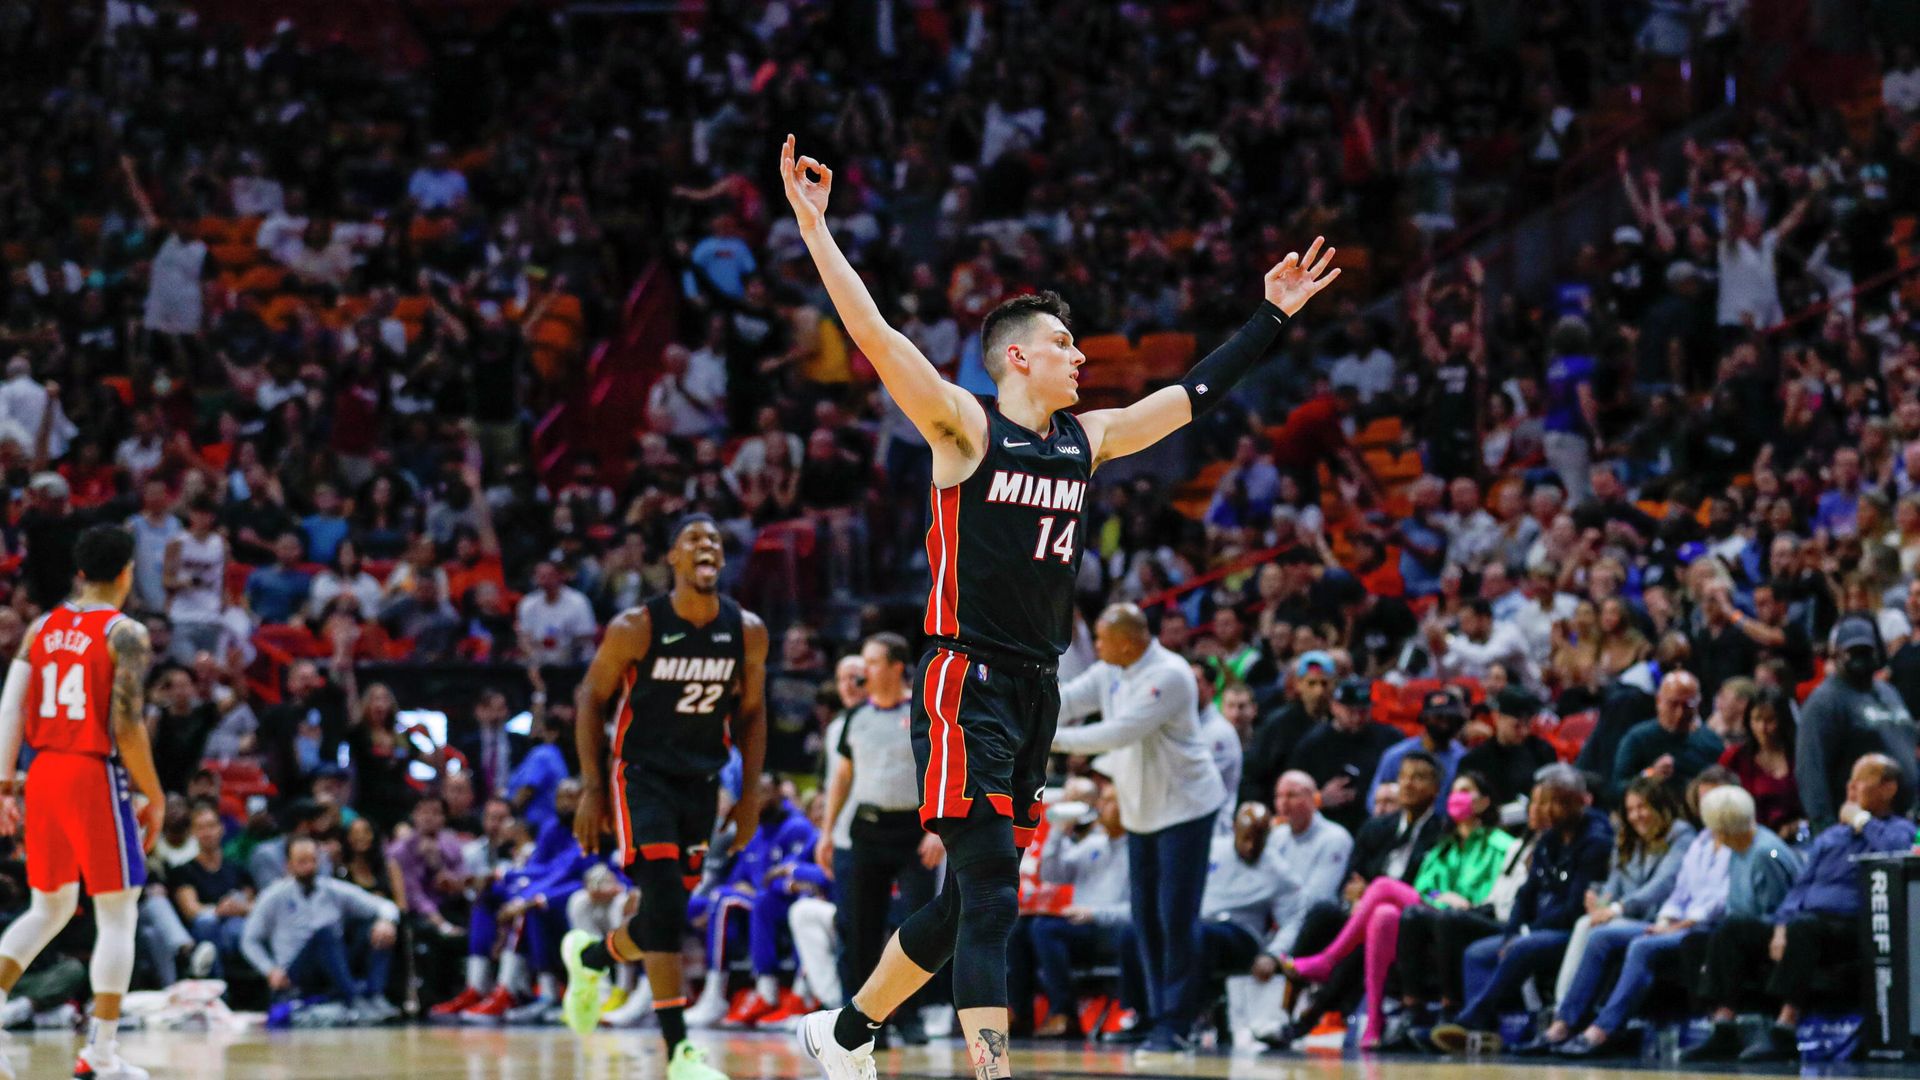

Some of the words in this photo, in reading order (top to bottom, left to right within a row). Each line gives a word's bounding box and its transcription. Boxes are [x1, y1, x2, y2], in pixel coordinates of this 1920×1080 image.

[1057, 446, 1080, 455] UKG
[986, 470, 1087, 512] MIAMI
[1033, 515, 1077, 564] 14
[44, 629, 92, 656] GREEN
[651, 657, 736, 681] MIAMI
[39, 662, 86, 720] 14
[675, 682, 724, 713] 22
[1870, 869, 1890, 953] REEF
